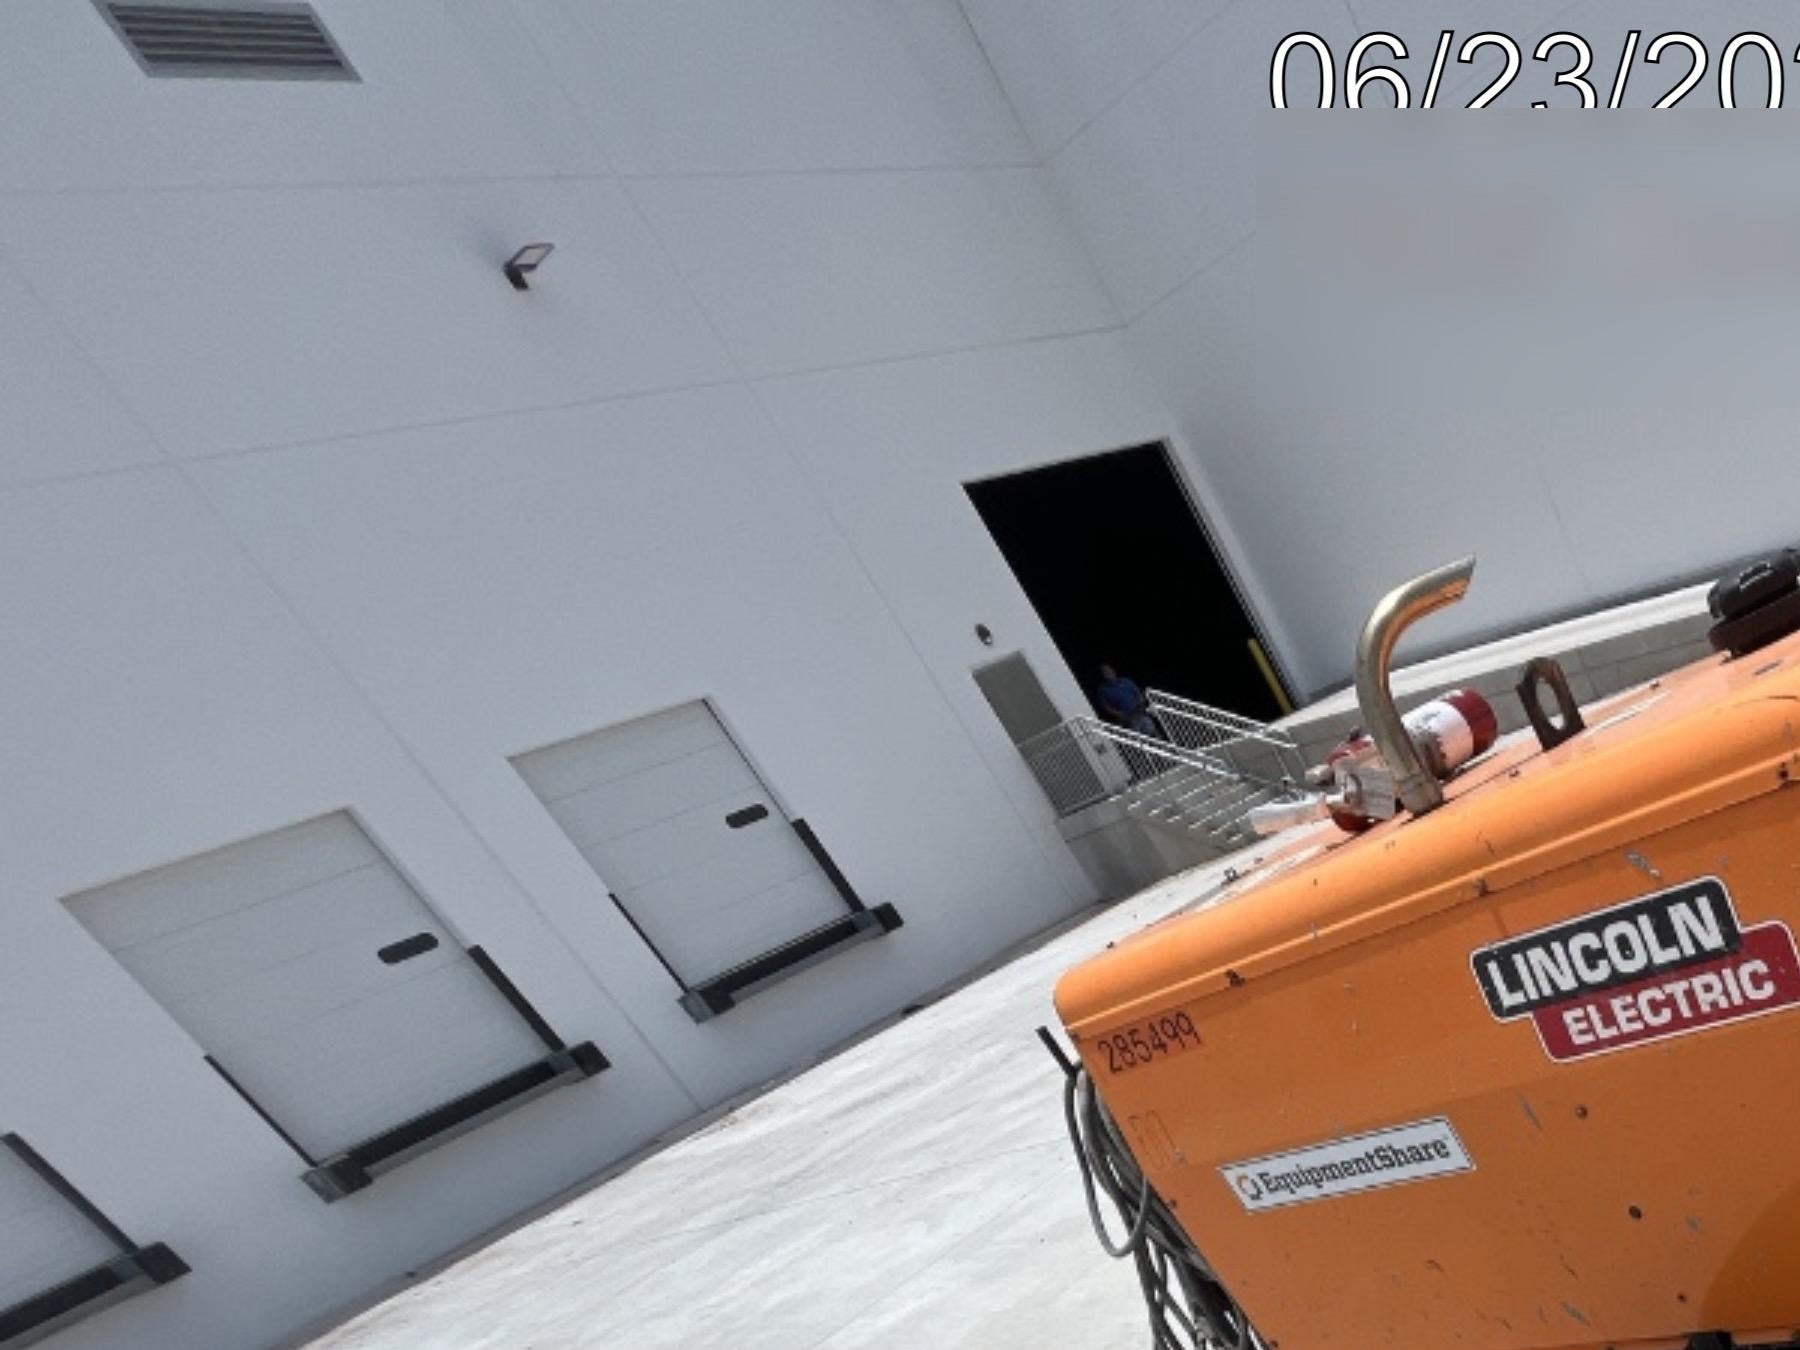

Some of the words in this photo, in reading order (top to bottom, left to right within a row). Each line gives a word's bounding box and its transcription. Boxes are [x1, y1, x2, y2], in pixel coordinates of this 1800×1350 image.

[1487, 896, 1725, 1007] LINCOLN
[1562, 958, 1775, 1046] ELECTRIC
[1097, 1009, 1202, 1075] 285499
[1257, 1139, 1451, 1194] EquipmentShare
